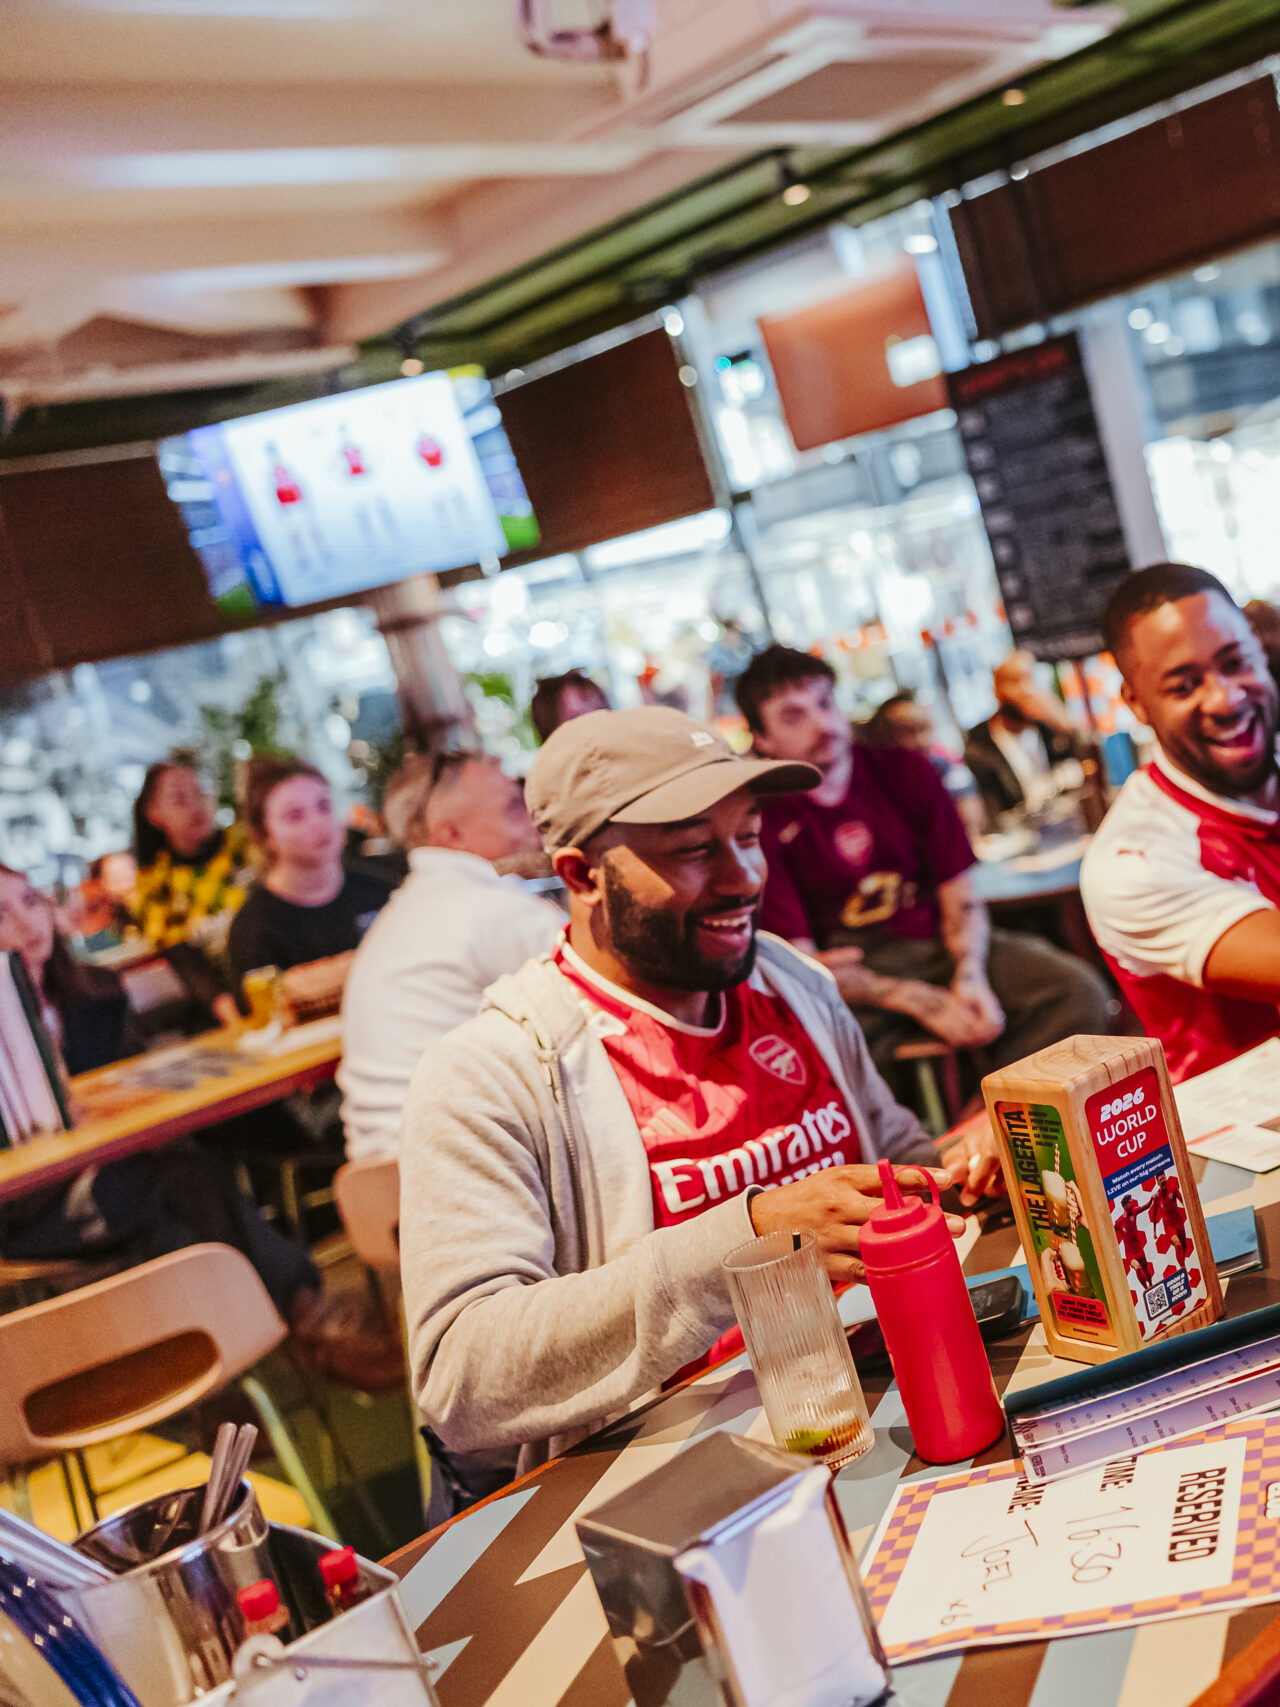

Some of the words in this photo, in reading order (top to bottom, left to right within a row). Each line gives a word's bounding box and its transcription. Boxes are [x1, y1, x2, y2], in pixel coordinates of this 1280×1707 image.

[1096, 1104, 1157, 1146] WORLD
[1100, 1087, 1145, 1123] 2026
[651, 1101, 851, 1213] Emirates
[1003, 1110, 1046, 1198] LAGERITA
[1117, 1131, 1147, 1158] CUP
[1107, 1182, 1122, 1195] LIVE
[1121, 1180, 1130, 1188] on
[1129, 1174, 1140, 1183] our
[1139, 1169, 1150, 1178] big
[1148, 1157, 1171, 1173] screens
[1112, 1170, 1130, 1184] Watch
[1130, 1163, 1146, 1175] every
[1145, 1153, 1163, 1166] match
[1027, 1199, 1051, 1231] THE
[1099, 1455, 1138, 1492] TIME:
[1168, 1466, 1227, 1562] RESERVED
[961, 1519, 1039, 1591] JOEL
[1066, 1505, 1140, 1583] 16:30
